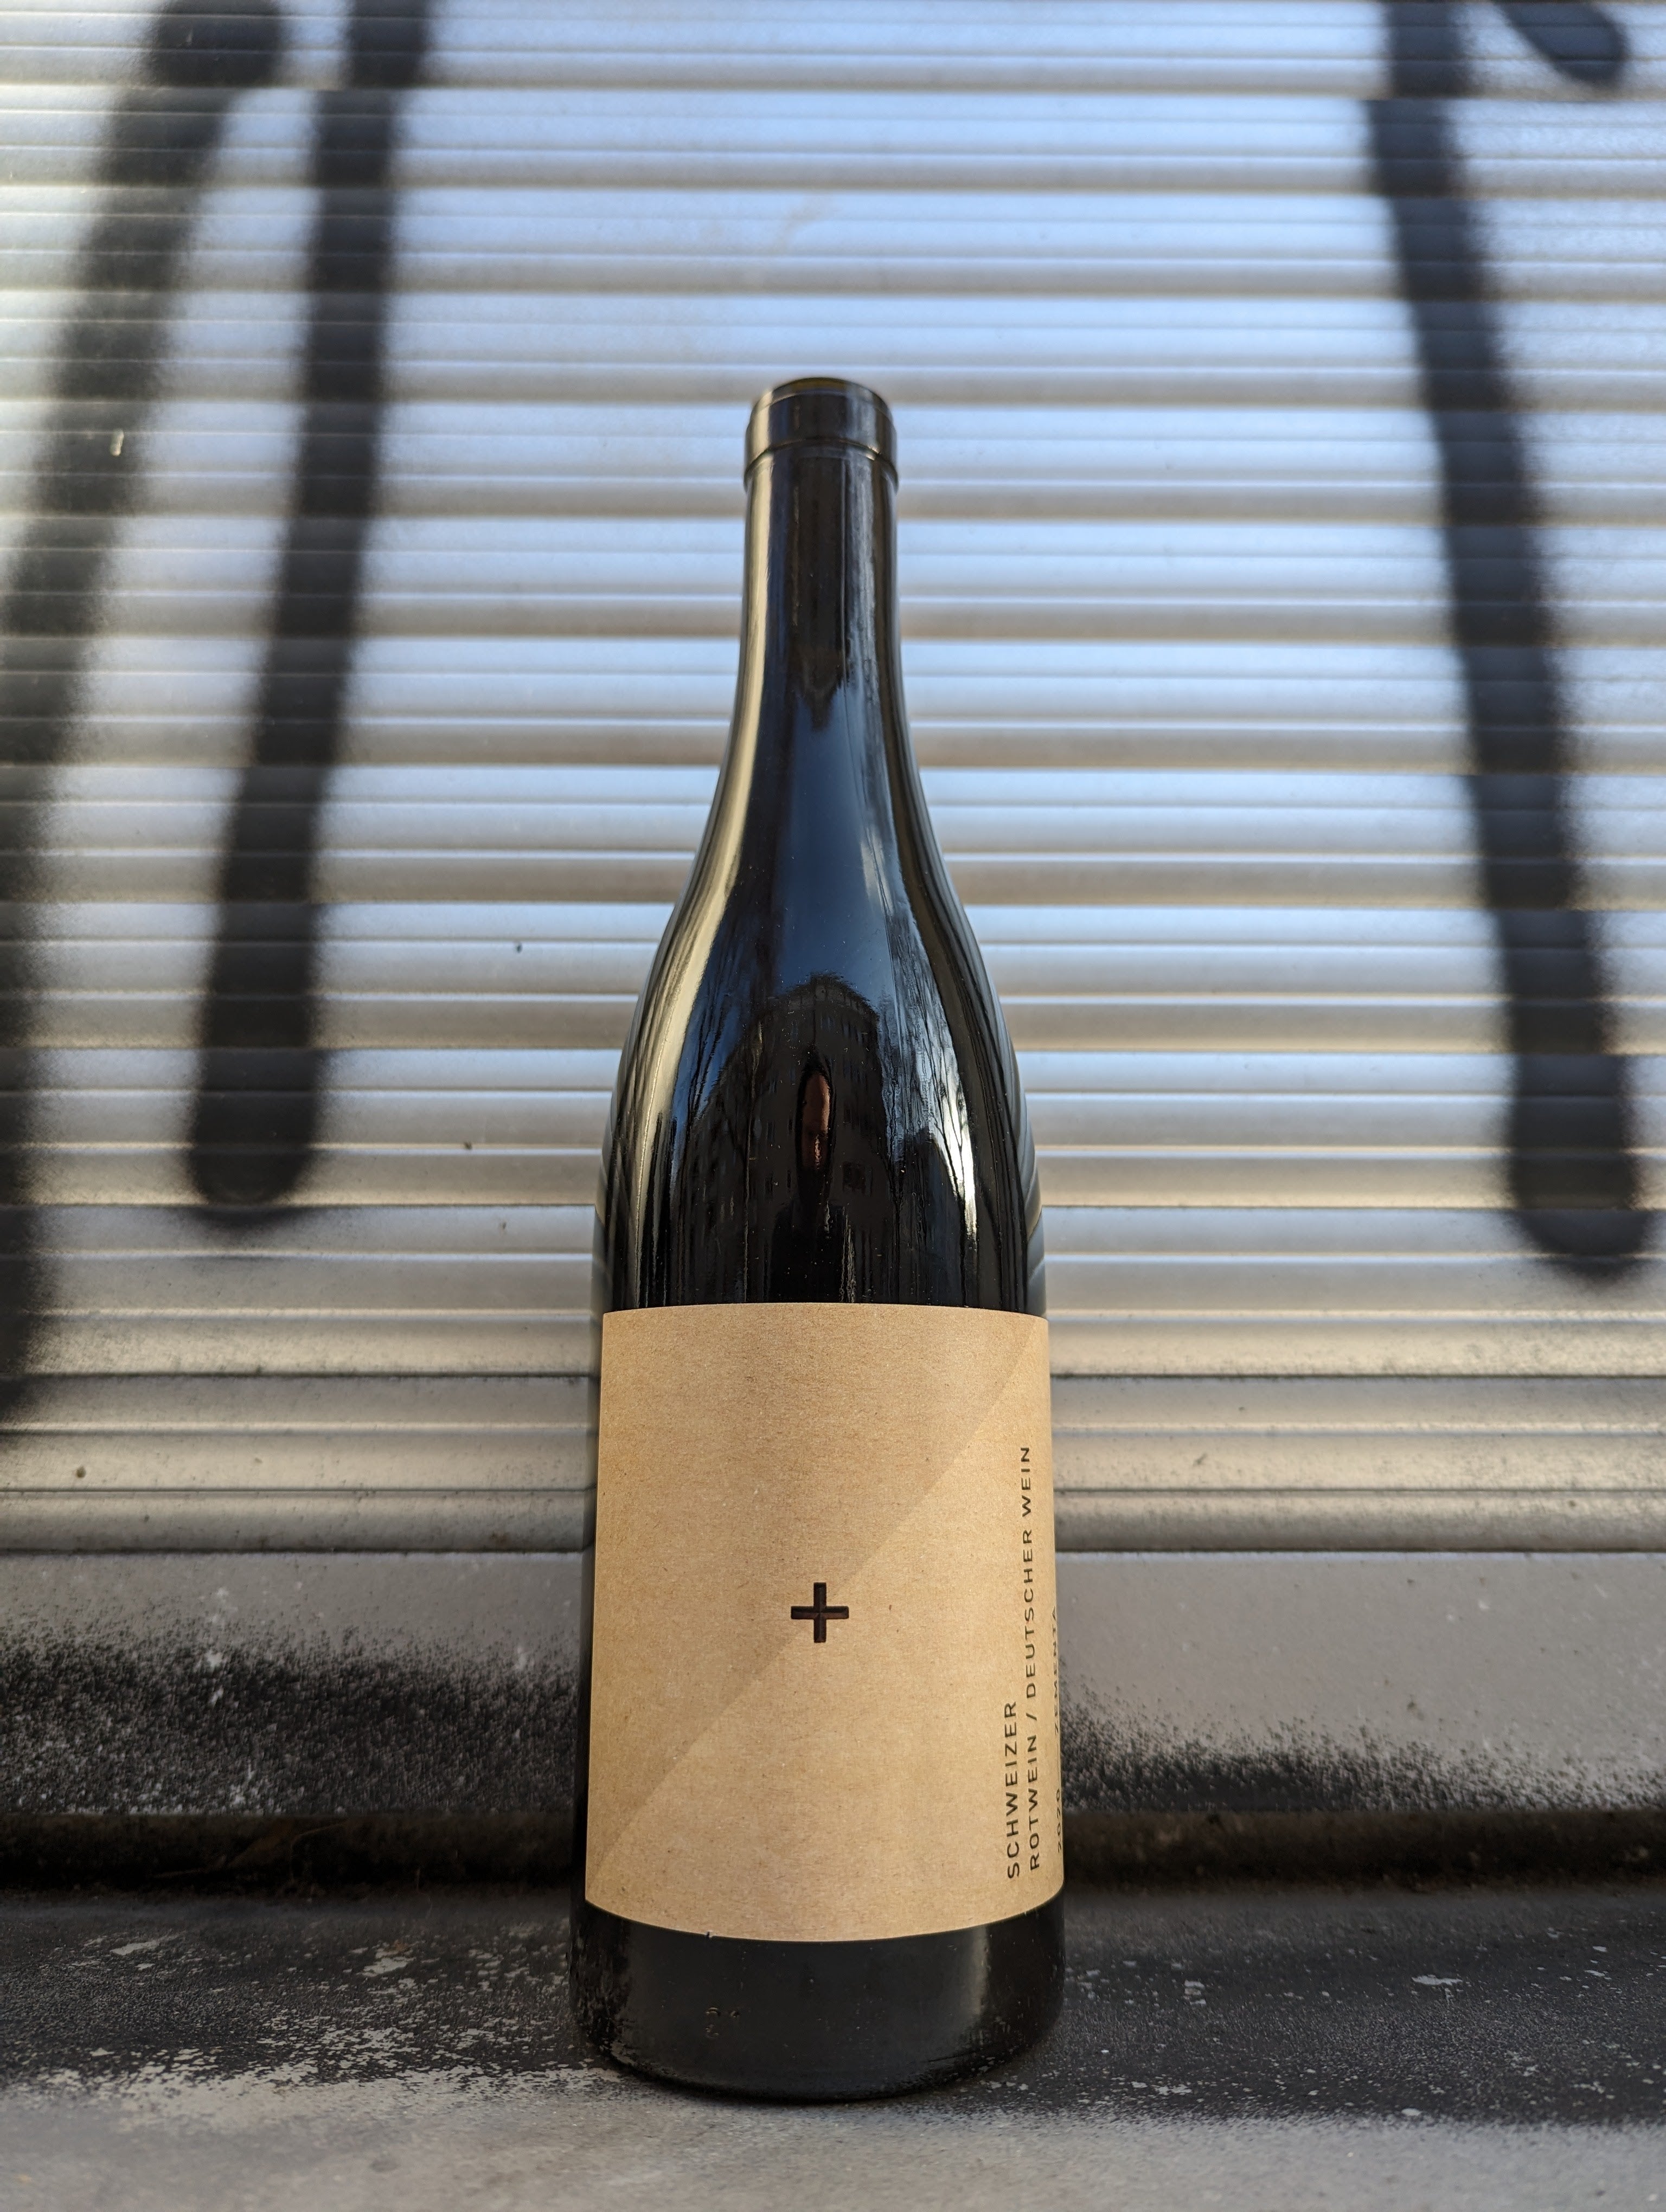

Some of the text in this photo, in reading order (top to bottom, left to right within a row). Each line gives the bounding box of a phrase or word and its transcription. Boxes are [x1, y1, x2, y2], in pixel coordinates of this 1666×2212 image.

[1004, 1701, 1020, 1879] SCHWEIZER
[1020, 1447, 1040, 1870] ROTWEIN / DEUTSCHER WEIN
